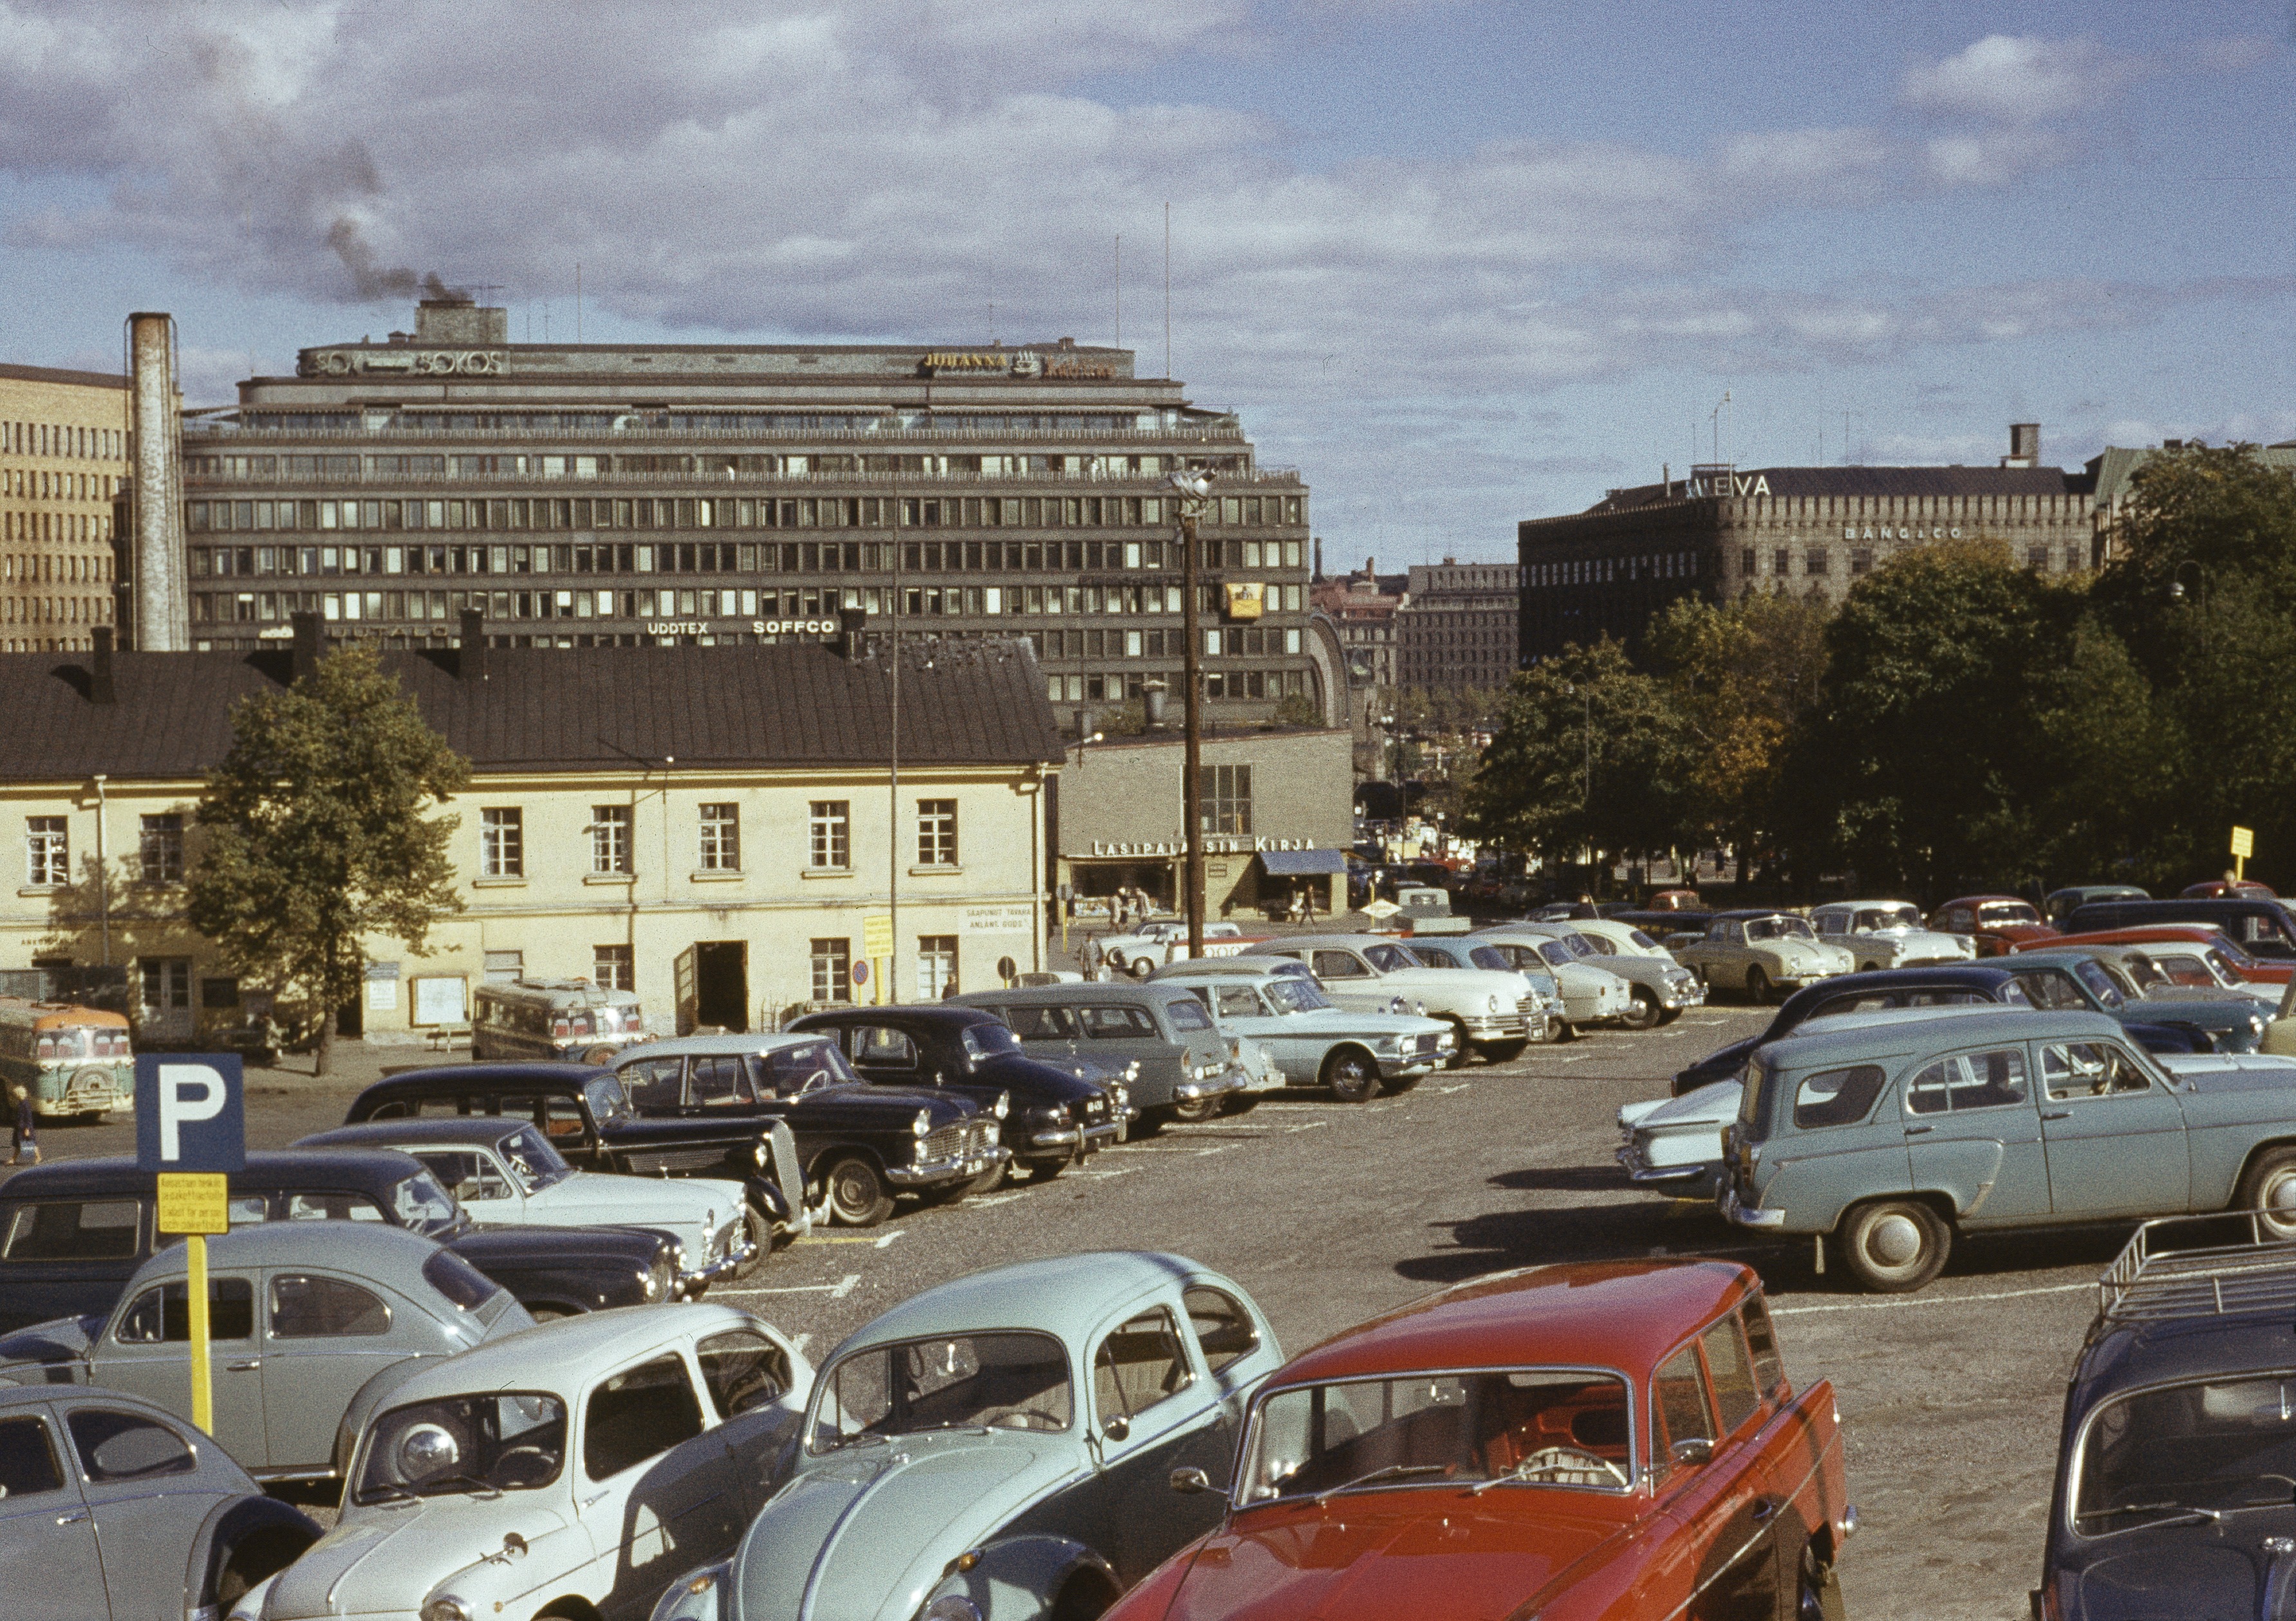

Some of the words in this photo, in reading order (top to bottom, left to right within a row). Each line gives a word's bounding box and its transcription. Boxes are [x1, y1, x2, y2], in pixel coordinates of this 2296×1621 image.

[416, 351, 501, 373] SOKOS
[925, 354, 1007, 368] JOHANNA
[648, 622, 707, 634] UDDTEX
[753, 621, 834, 633] SOFFCO
[1094, 840, 1238, 856] LASIPALASIN
[1255, 837, 1315, 852] KIRJA
[159, 1064, 226, 1161] P
